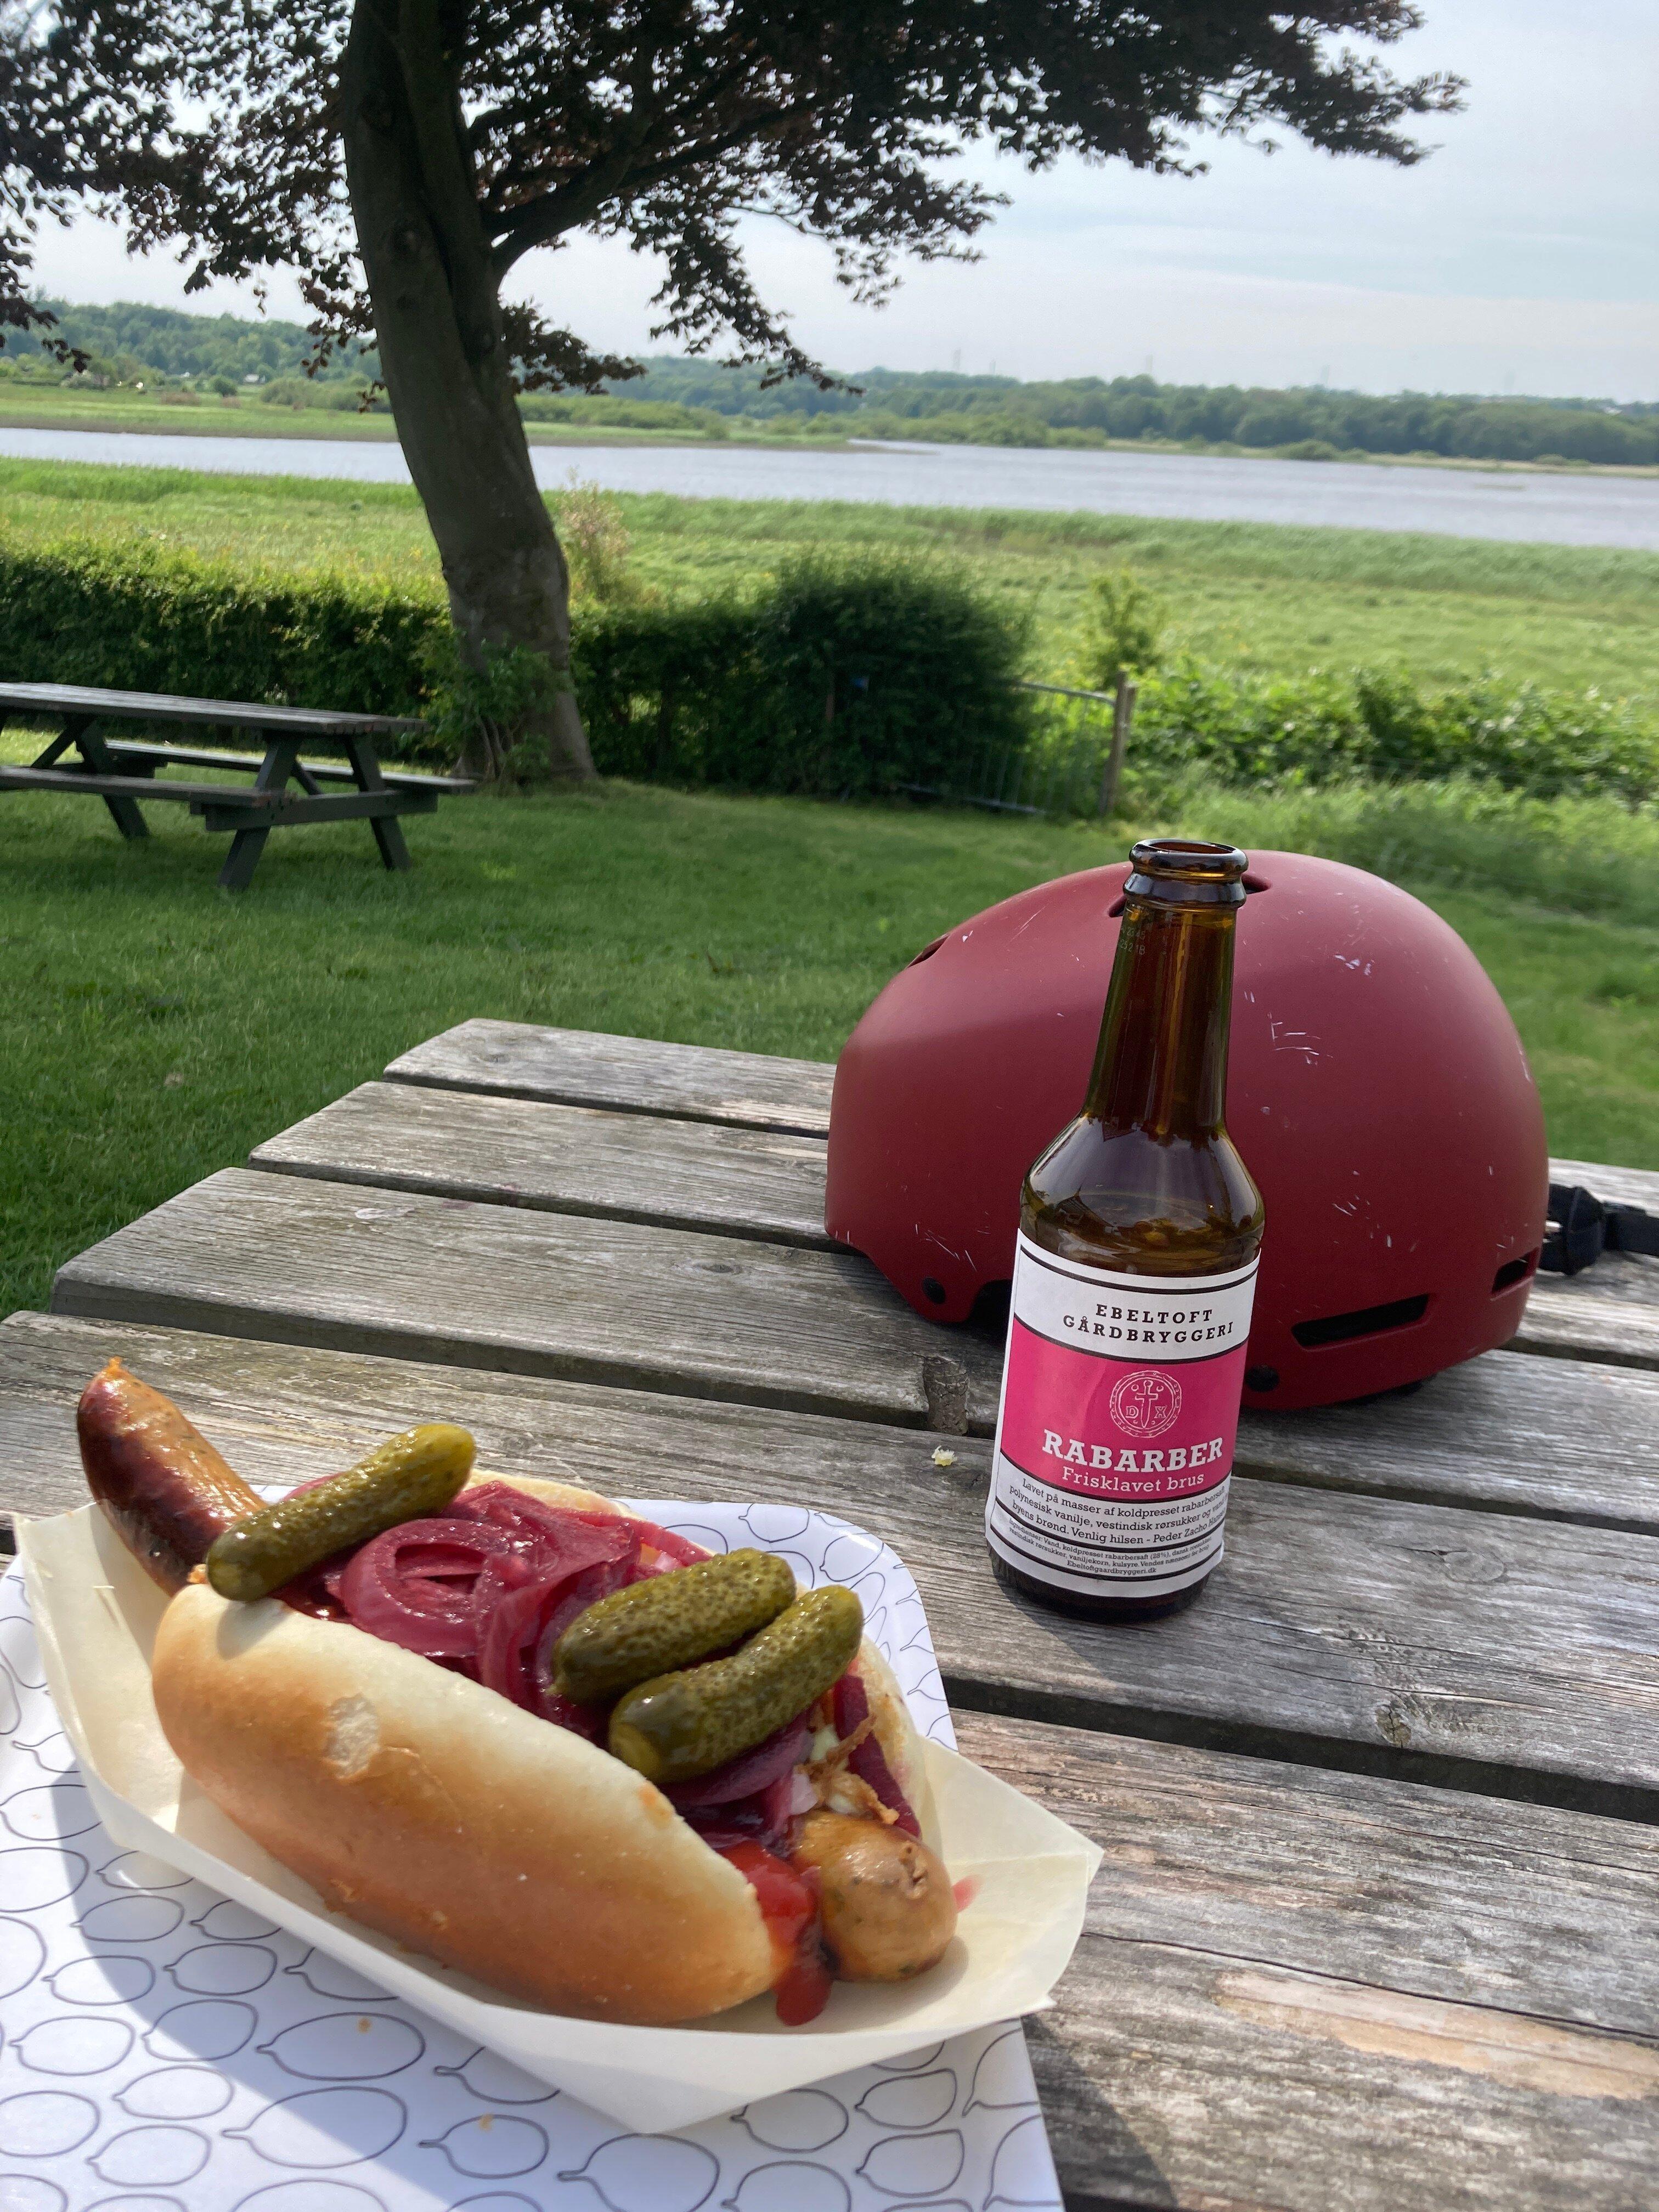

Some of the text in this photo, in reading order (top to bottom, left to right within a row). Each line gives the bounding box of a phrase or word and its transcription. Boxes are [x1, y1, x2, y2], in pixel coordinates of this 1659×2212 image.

[1096, 1304, 1212, 1323] EBELTOFT
[1063, 1315, 1233, 1342] GÅRDBRYGGERI
[1042, 1429, 1223, 1472] RABARBER
[1062, 1466, 1205, 1492] Frisklavet brus
[1009, 1485, 1052, 1515] polynesisk
[1054, 1510, 1093, 1528] vanilje,
[1096, 1520, 1153, 1531] vestindisk
[1155, 1513, 1201, 1530] rørsukker
[1201, 1509, 1211, 1519] og
[1023, 1478, 1045, 1497] Lavet
[1046, 1492, 1059, 1504] på
[1062, 1498, 1102, 1514] masser
[1104, 1508, 1116, 1516] af
[1118, 1505, 1180, 1519] koldpresset
[1012, 1499, 1034, 1521] byens
[1036, 1515, 1070, 1534] brønd.
[1071, 1526, 1107, 1544] Venlig
[1109, 1534, 1143, 1544] hilsen
[1153, 1532, 1183, 1543] Peder
[1184, 1523, 1207, 1537] Zacho
[1063, 1544, 1103, 1558] koldpresset
[1067, 1560, 1156, 1576] Ebeltoftgaardbryggeri.dk
